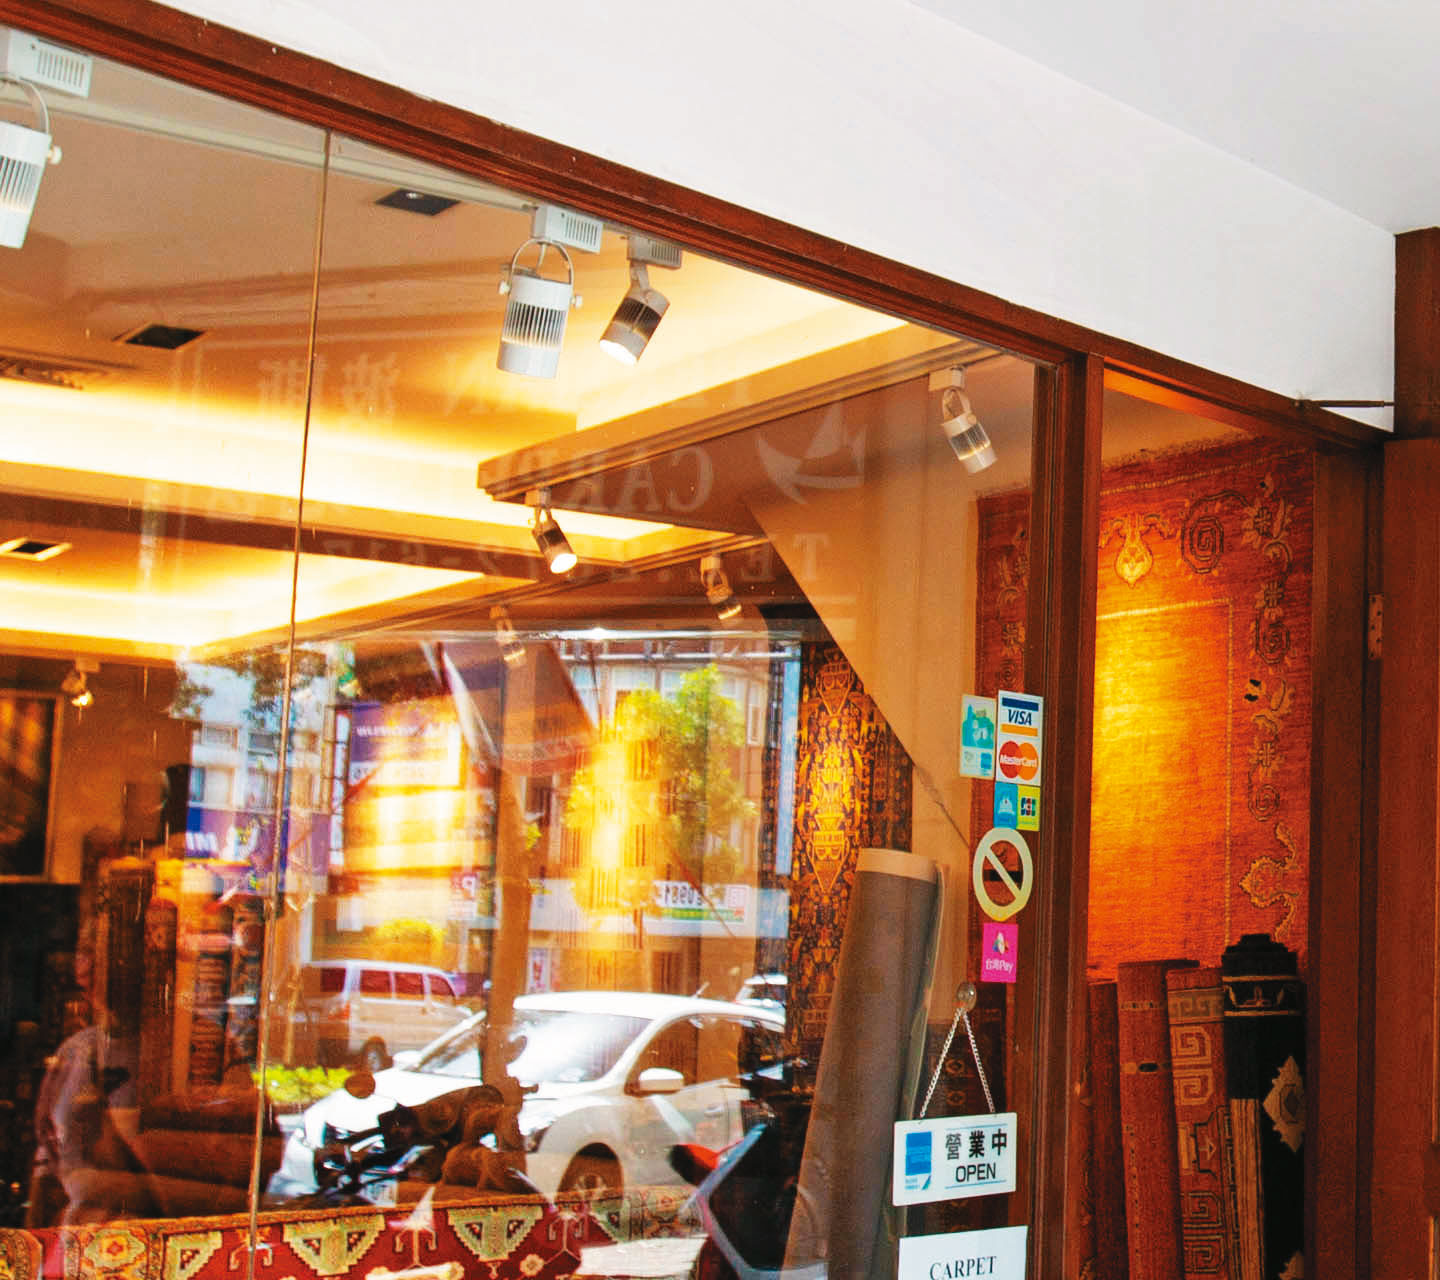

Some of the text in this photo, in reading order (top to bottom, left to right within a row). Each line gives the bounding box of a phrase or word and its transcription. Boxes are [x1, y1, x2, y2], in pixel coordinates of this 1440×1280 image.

[1007, 708, 1033, 726] VISA
[945, 1128, 1008, 1161] 營業中
[955, 1163, 997, 1184] OPEN
